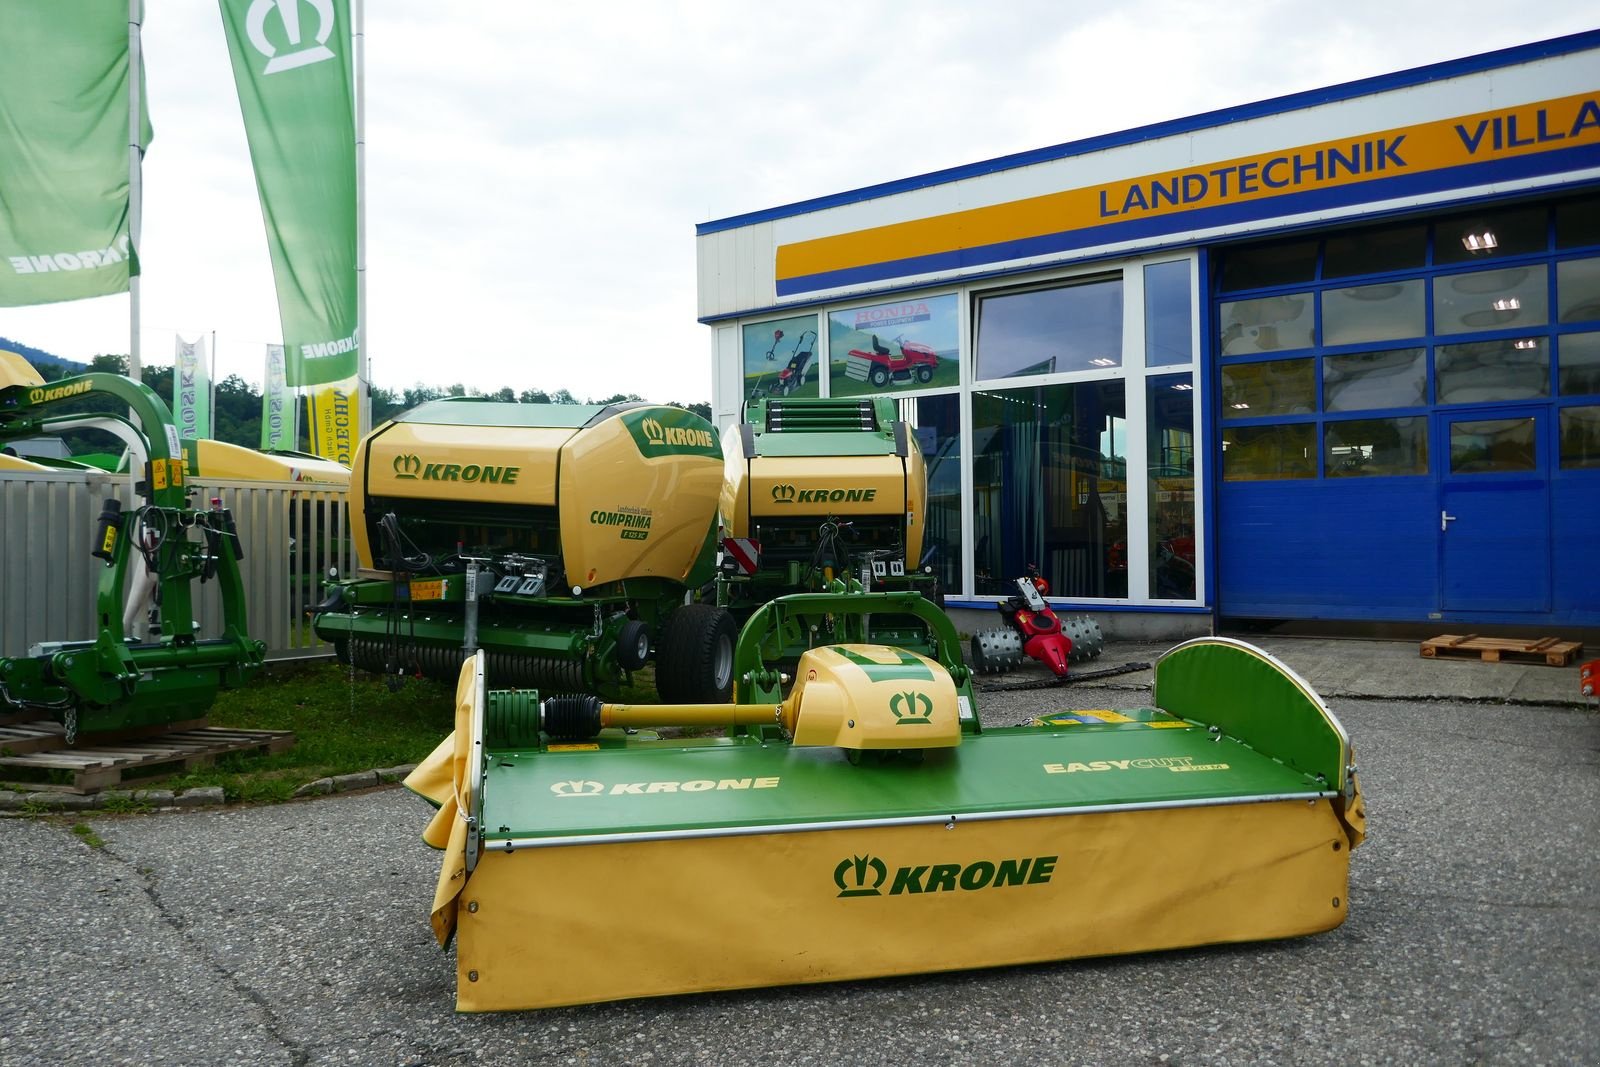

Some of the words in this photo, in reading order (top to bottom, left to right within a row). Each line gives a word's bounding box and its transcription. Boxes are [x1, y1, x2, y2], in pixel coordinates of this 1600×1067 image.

[1100, 135, 1407, 218] LANDTECHNIK
[1454, 99, 1600, 154] VILLA
[856, 303, 929, 322] HONDA
[45, 379, 93, 402] KRONE
[665, 426, 713, 447] KRONE
[422, 463, 520, 485] KRONE
[797, 488, 877, 503] KRONE
[590, 510, 652, 529] COMPRIMA
[1043, 756, 1193, 774] EASYCUT
[609, 776, 781, 796] KRONE
[888, 855, 1059, 896] KRONE
